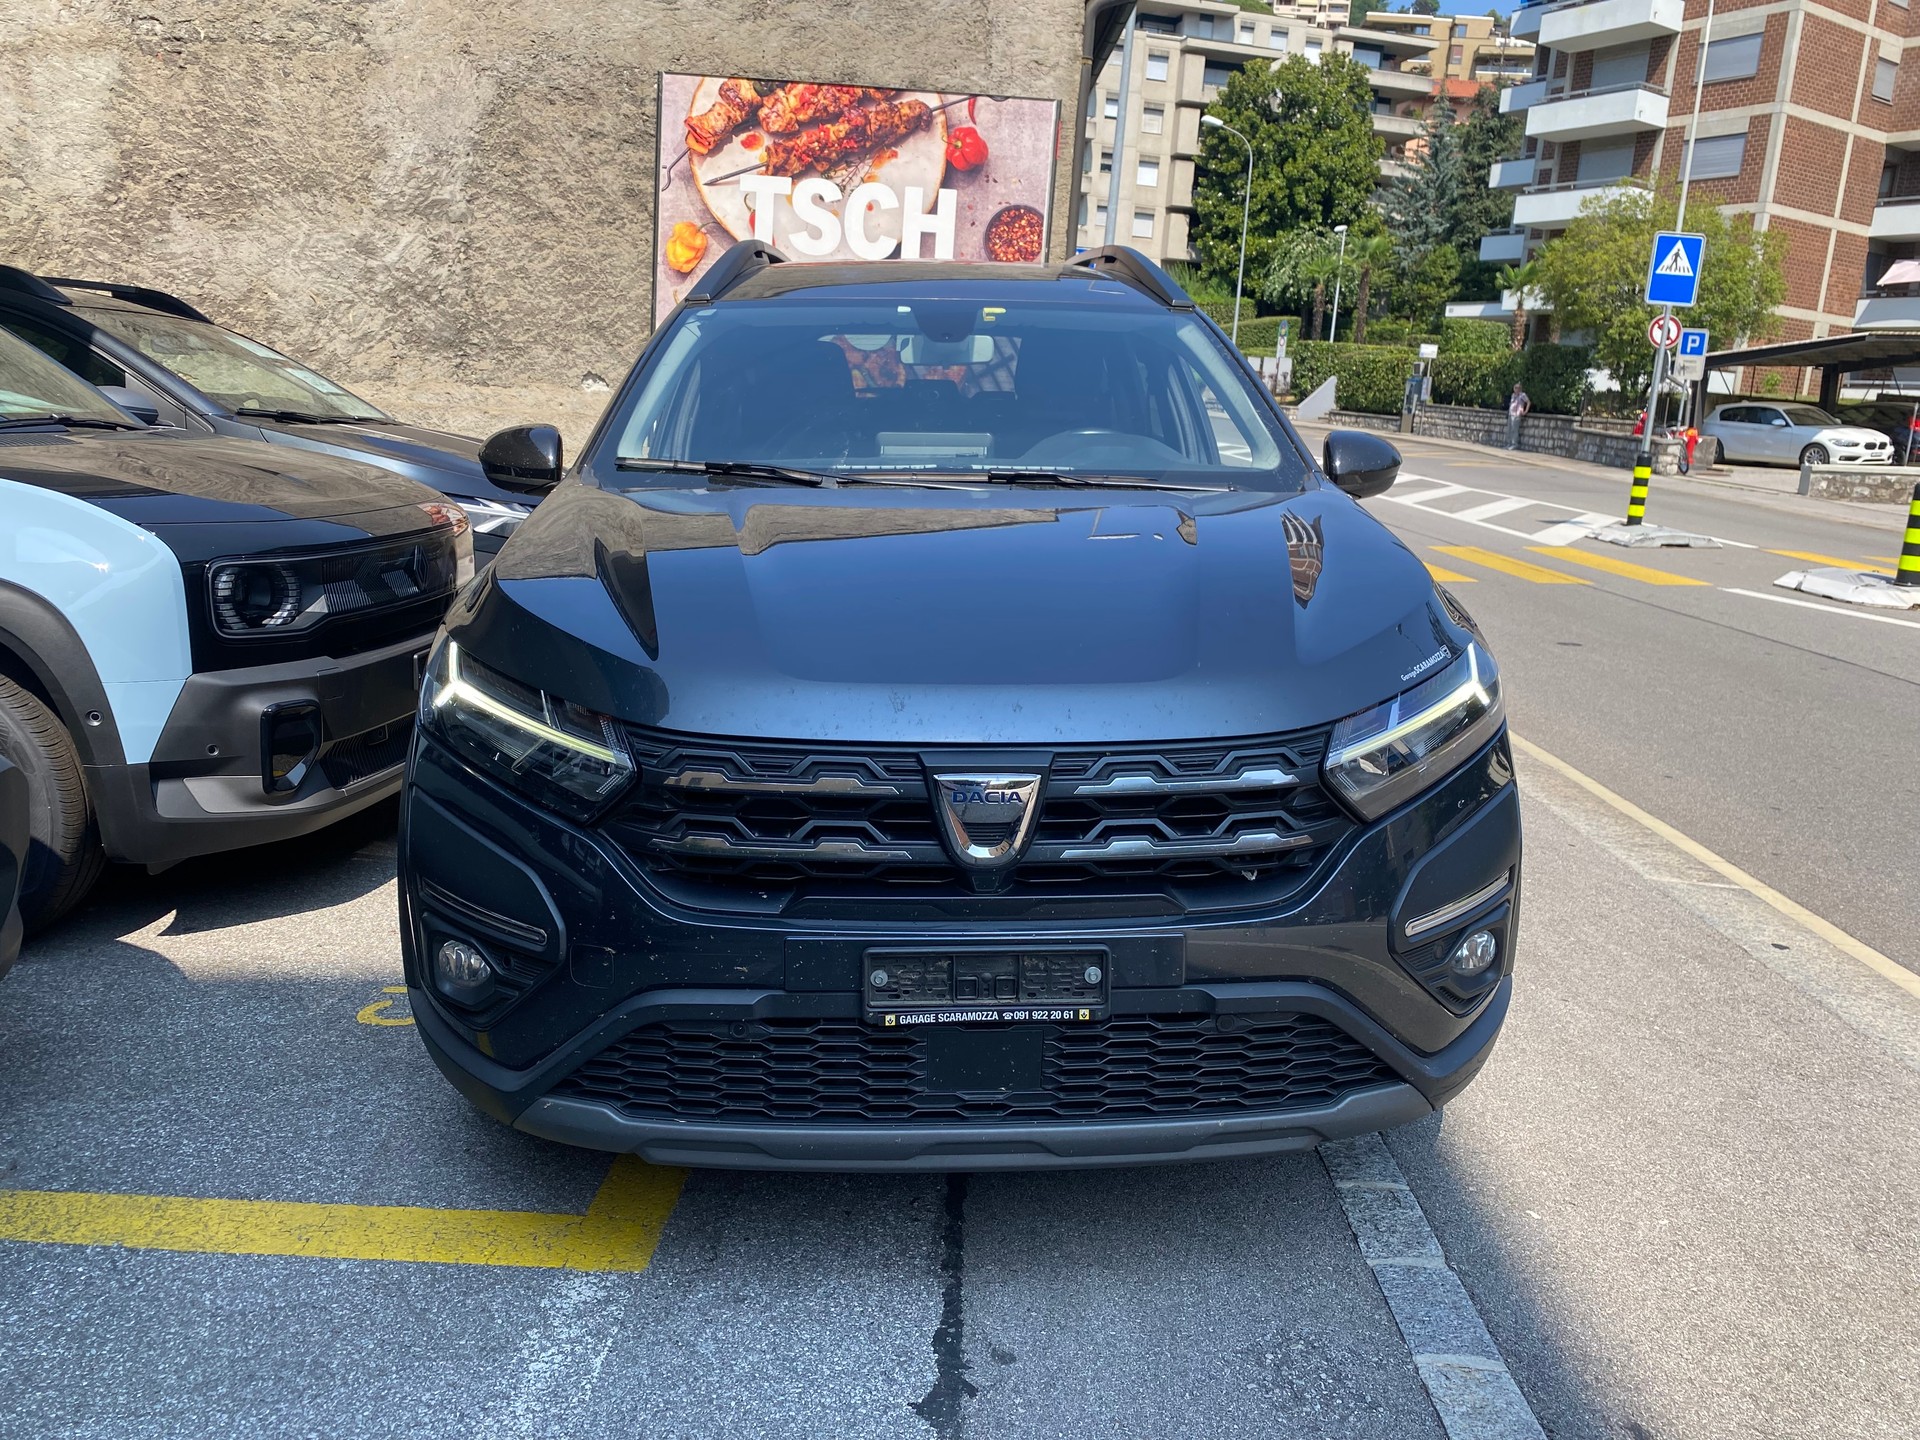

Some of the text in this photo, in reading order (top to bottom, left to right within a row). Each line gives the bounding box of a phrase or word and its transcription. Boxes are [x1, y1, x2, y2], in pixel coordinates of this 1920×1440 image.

[739, 174, 957, 261] TSCH
[1687, 335, 1700, 354] P
[952, 791, 1022, 804] DACIA
[899, 1010, 1074, 1025] GARAGE SCARAMOZZA 091 922 20 61
